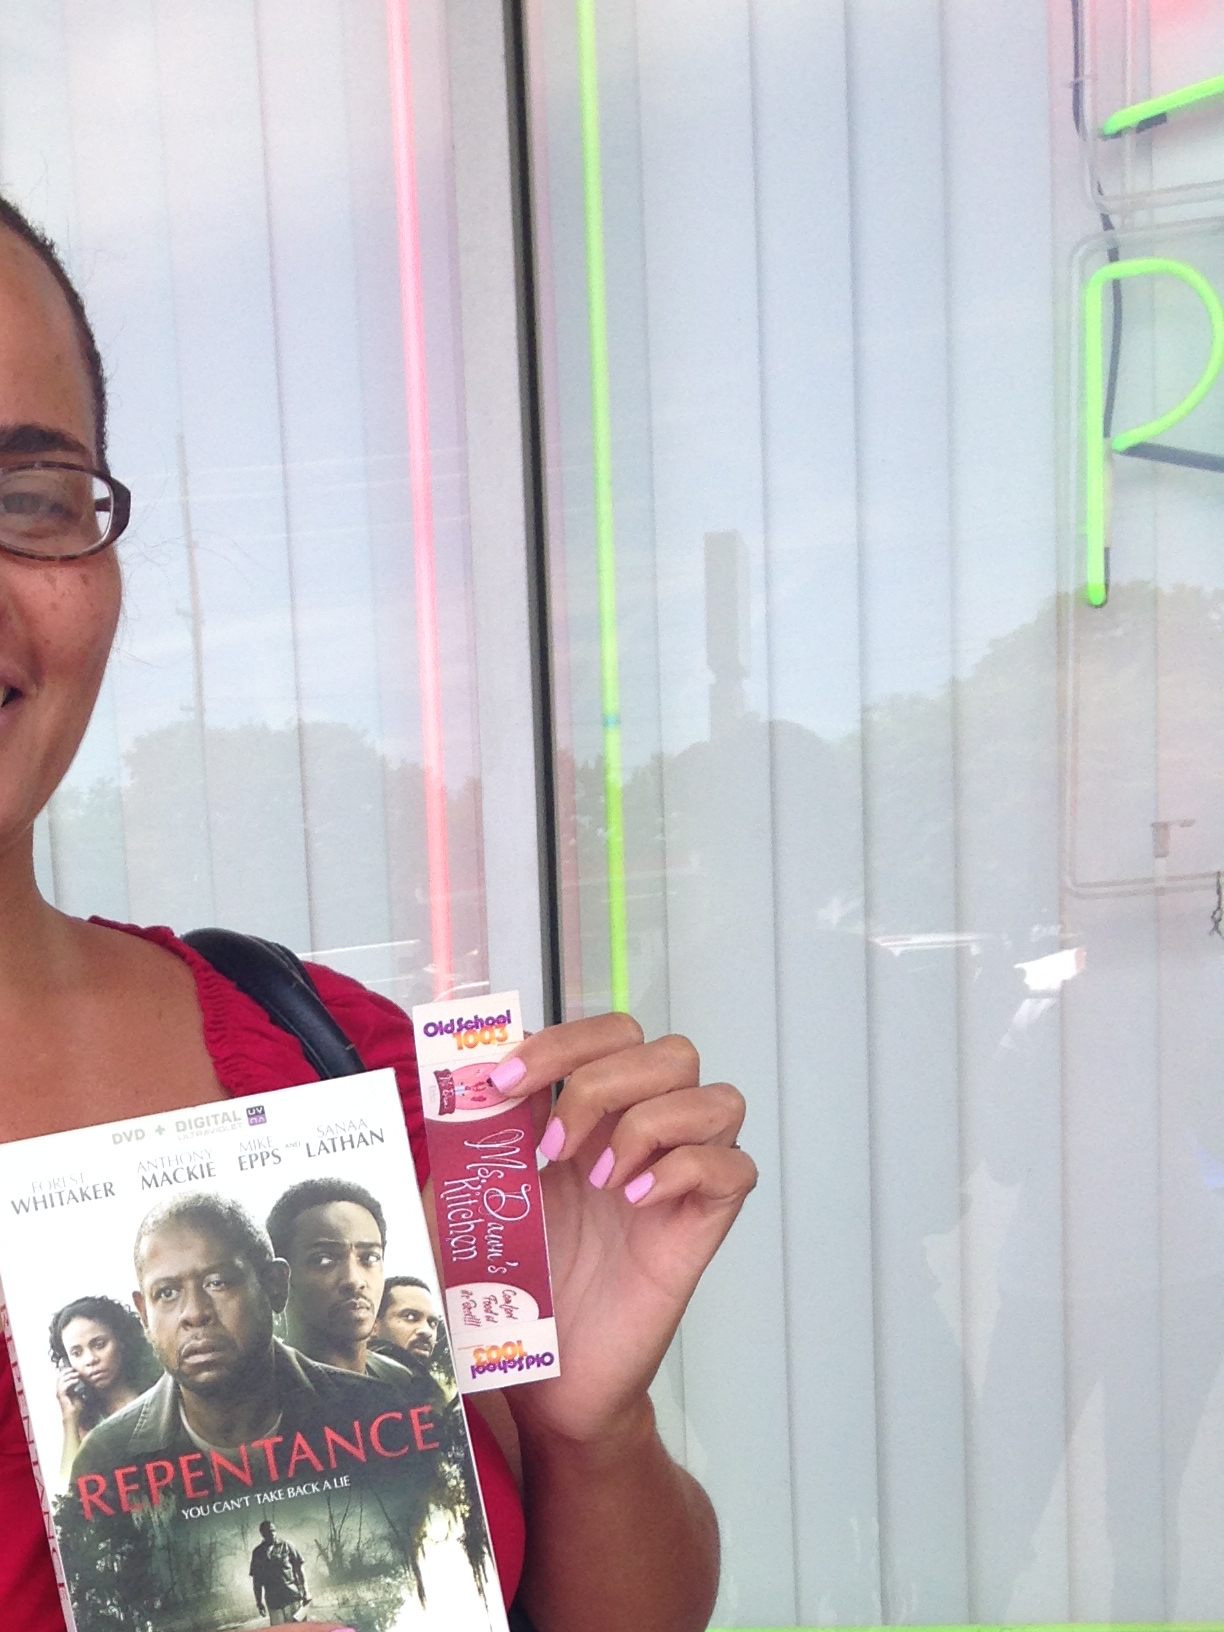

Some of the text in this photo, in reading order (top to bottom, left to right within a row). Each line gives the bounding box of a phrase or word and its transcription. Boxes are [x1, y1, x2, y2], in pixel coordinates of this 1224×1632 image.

[111, 1128, 146, 1145] DVD
[175, 1110, 242, 1133] DIGITAL
[178, 1122, 243, 1141] ULTRAVIOLET
[316, 1117, 369, 1138] SANAA
[239, 1135, 274, 1153] MIKE
[305, 1127, 385, 1158] LATHAN
[136, 1148, 213, 1174] ANTHONY
[237, 1148, 283, 1171] EPPS
[31, 1171, 86, 1193] FOREST
[140, 1161, 217, 1190] MACKIE
[10, 1180, 116, 1215] WHITAKER
[440, 1176, 485, 1263] Kitchen
[77, 1404, 441, 1523] REPENTANCE
[181, 1474, 351, 1520] YOU CAN'T TAKE BACK A LIE
